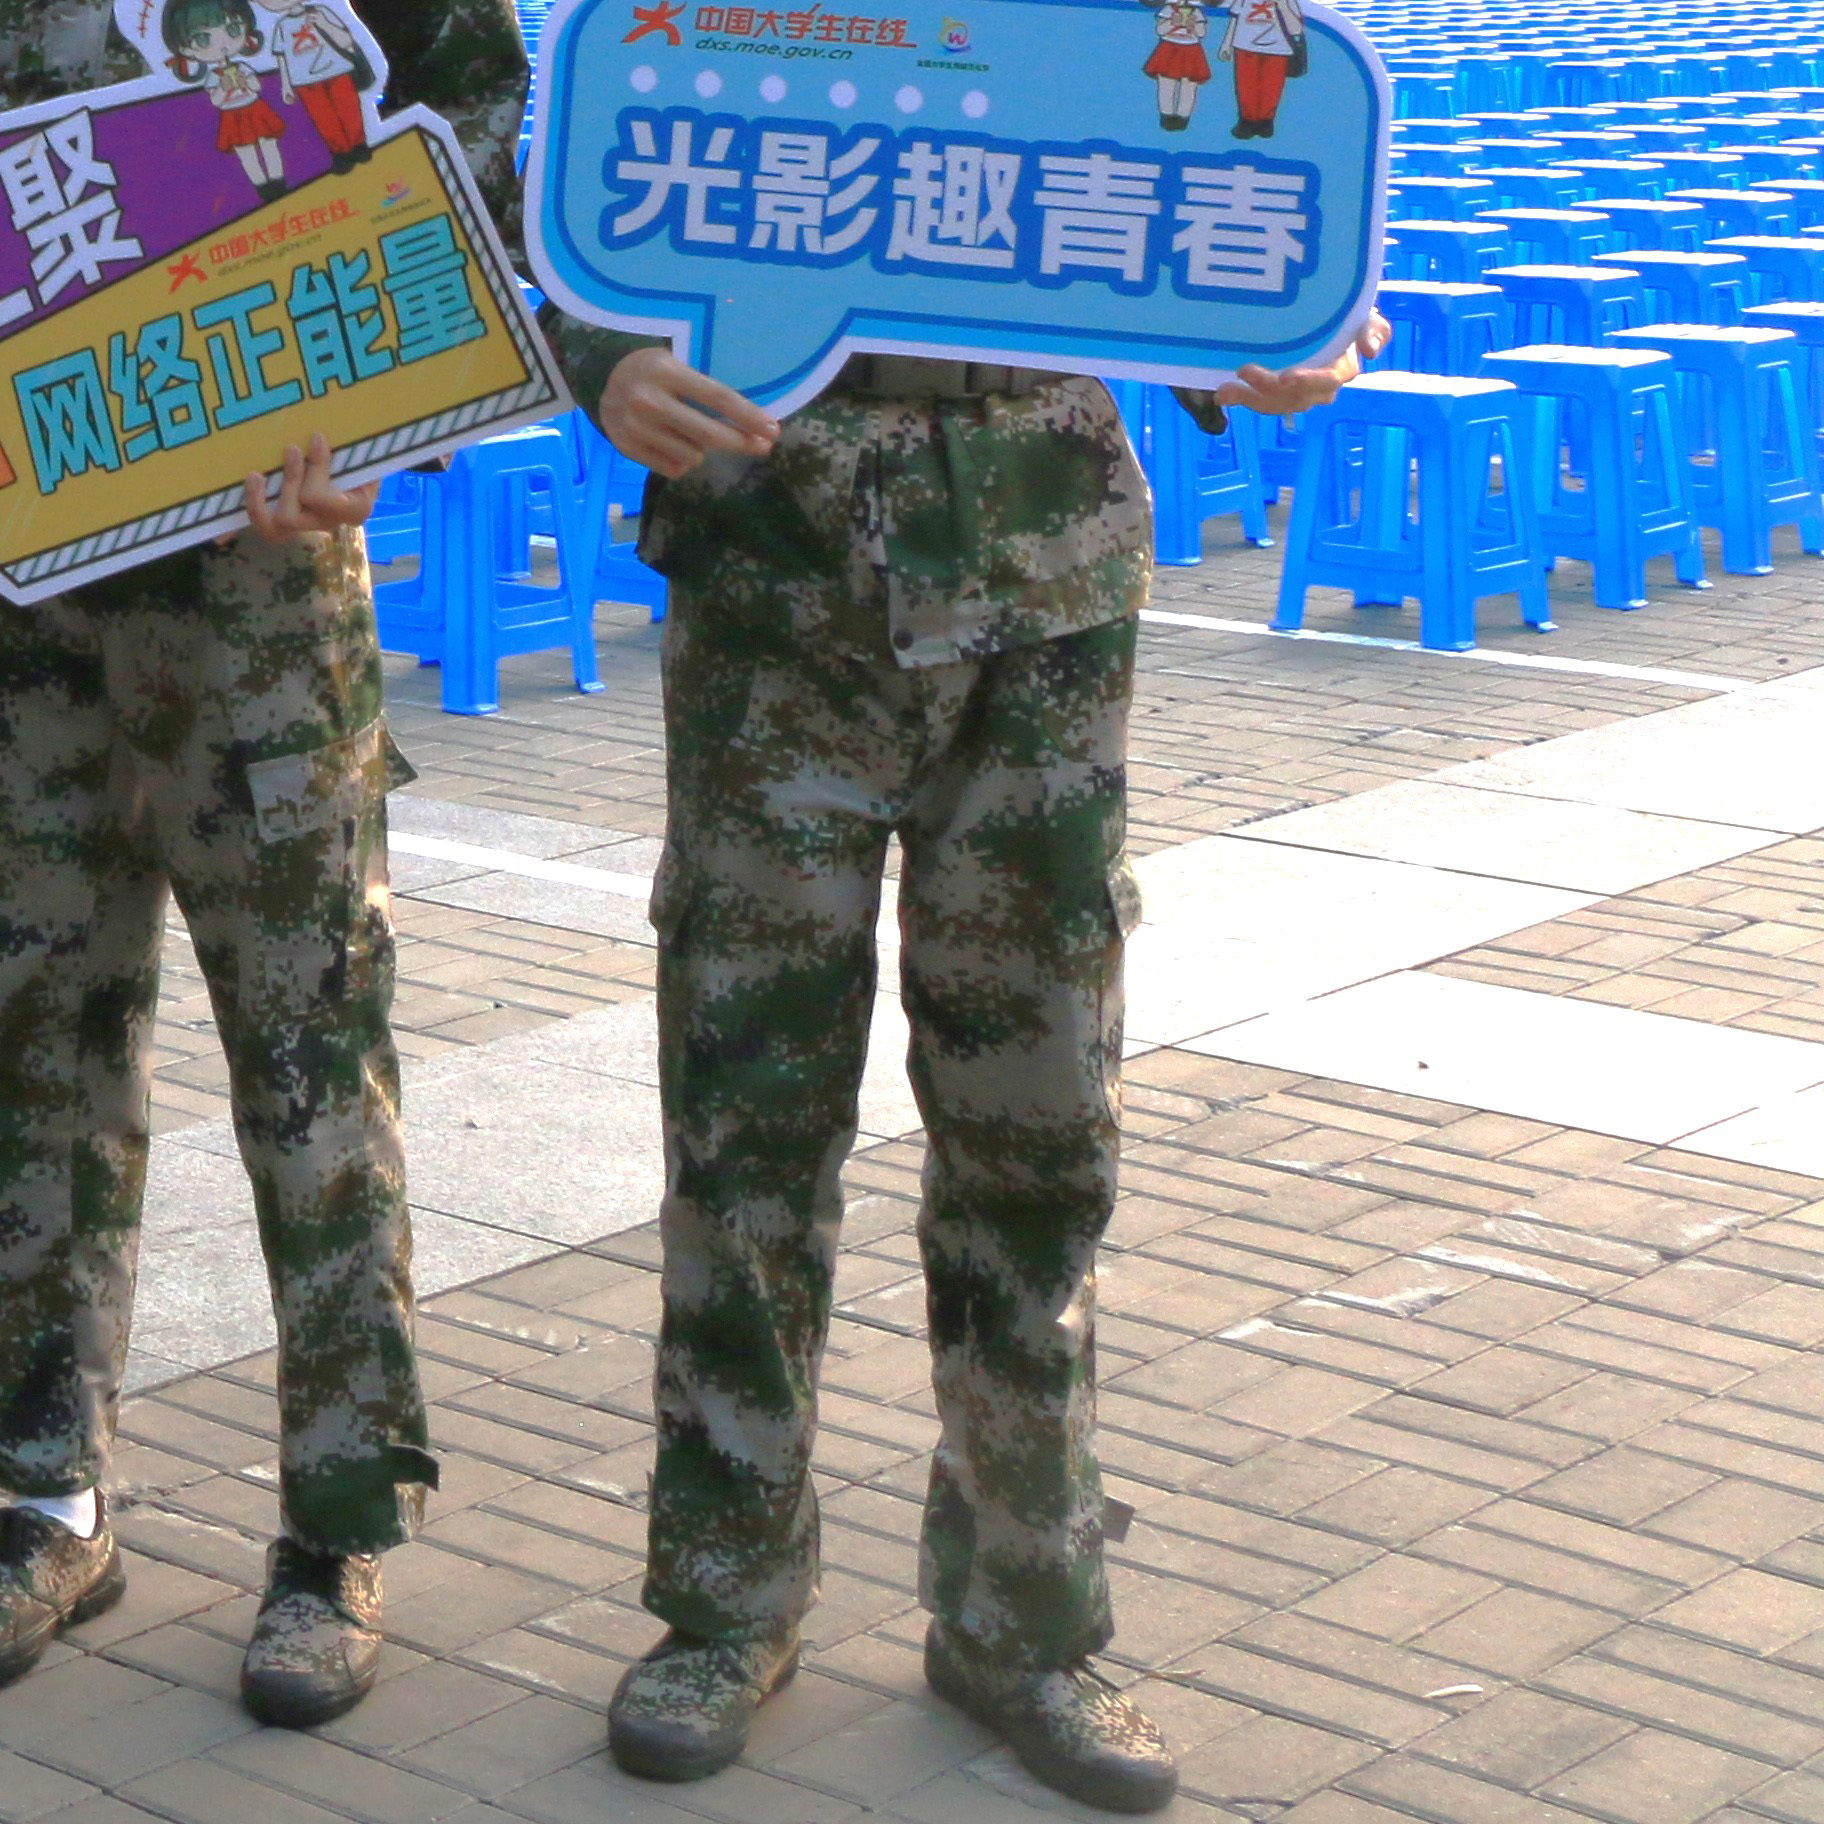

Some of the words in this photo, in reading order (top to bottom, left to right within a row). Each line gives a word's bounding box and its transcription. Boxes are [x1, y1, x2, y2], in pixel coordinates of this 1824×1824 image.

[694, 3, 917, 49] 中国大学生在线
[694, 36, 854, 60] dxs.moe.gov.cn
[610, 114, 1310, 297] 光影趣青春
[12, 212, 488, 494] 网络正能量
